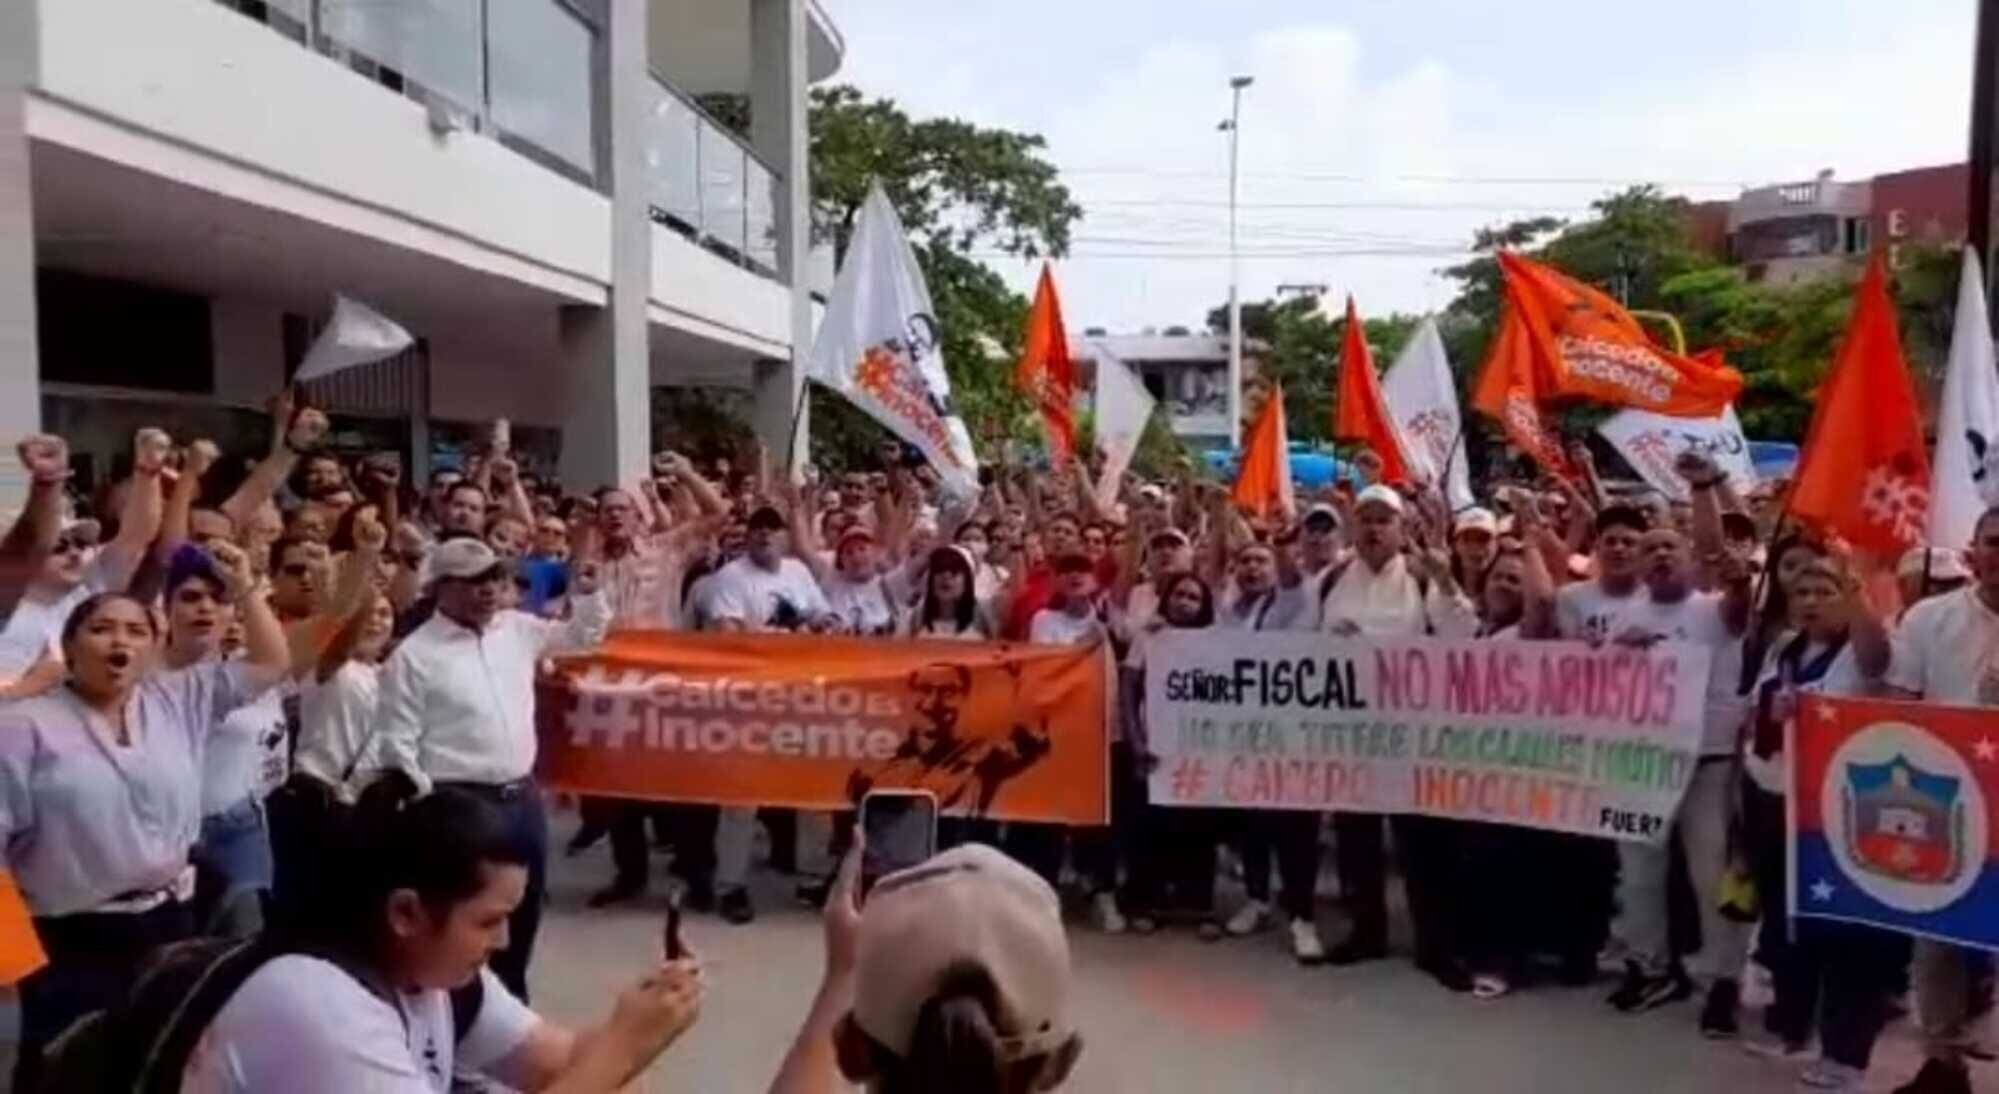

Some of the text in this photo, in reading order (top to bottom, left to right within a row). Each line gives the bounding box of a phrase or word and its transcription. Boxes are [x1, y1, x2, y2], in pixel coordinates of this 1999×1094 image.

[1233, 657, 1367, 710] FISCAL
[1374, 649, 1430, 712] NO
[1535, 651, 1678, 726] ABUSOS
[644, 706, 900, 760] Inocente
